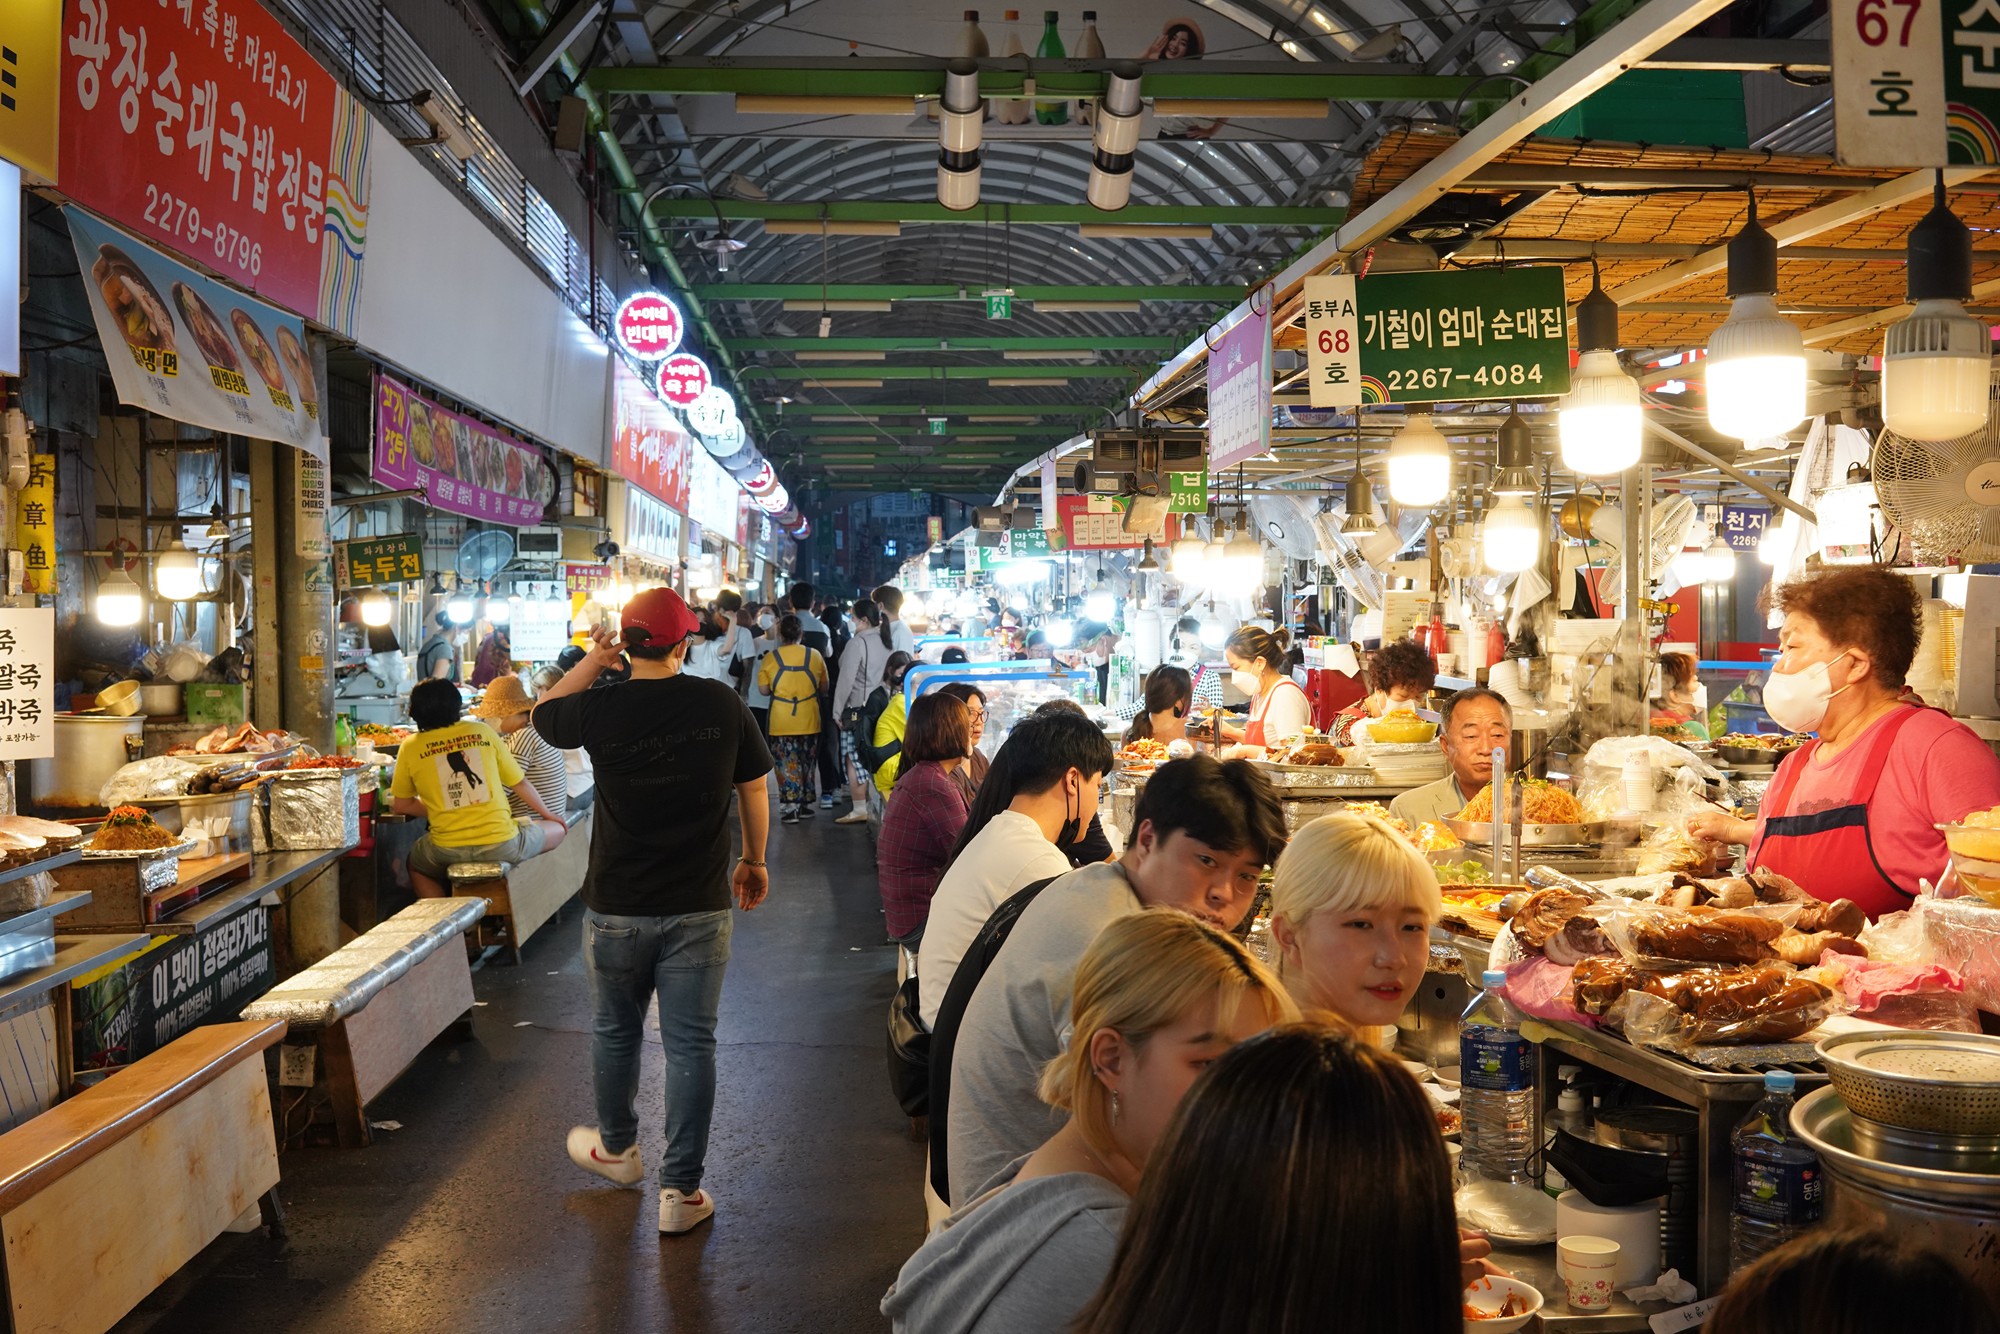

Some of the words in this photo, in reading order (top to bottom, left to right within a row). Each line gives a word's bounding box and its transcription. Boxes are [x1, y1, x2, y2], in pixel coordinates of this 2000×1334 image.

[1856, 0, 1922, 47] 67
[245, 35, 307, 123] 머리고기
[1868, 71, 1918, 116] 호
[144, 184, 262, 276] 2279-8796
[1308, 298, 1355, 319] 동부A
[1317, 329, 1350, 354] 68
[1364, 308, 1433, 351] 기철이
[1438, 306, 1484, 347] 엄마
[1491, 306, 1563, 341] 순대집
[211, 367, 250, 396] 비빔냉면
[1323, 362, 1350, 385] 호
[1387, 363, 1543, 391] 2267-4084
[352, 553, 421, 583] 녹두전
[567, 575, 609, 591] 머릿고기
[447, 734, 482, 744] LIMITED
[457, 740, 490, 749] EDITION
[153, 959, 168, 1009] 이
[172, 940, 200, 998] 맛이
[203, 907, 268, 978] 청정라거다!
[220, 971, 239, 997] 100%
[155, 1007, 178, 1047] 100%
